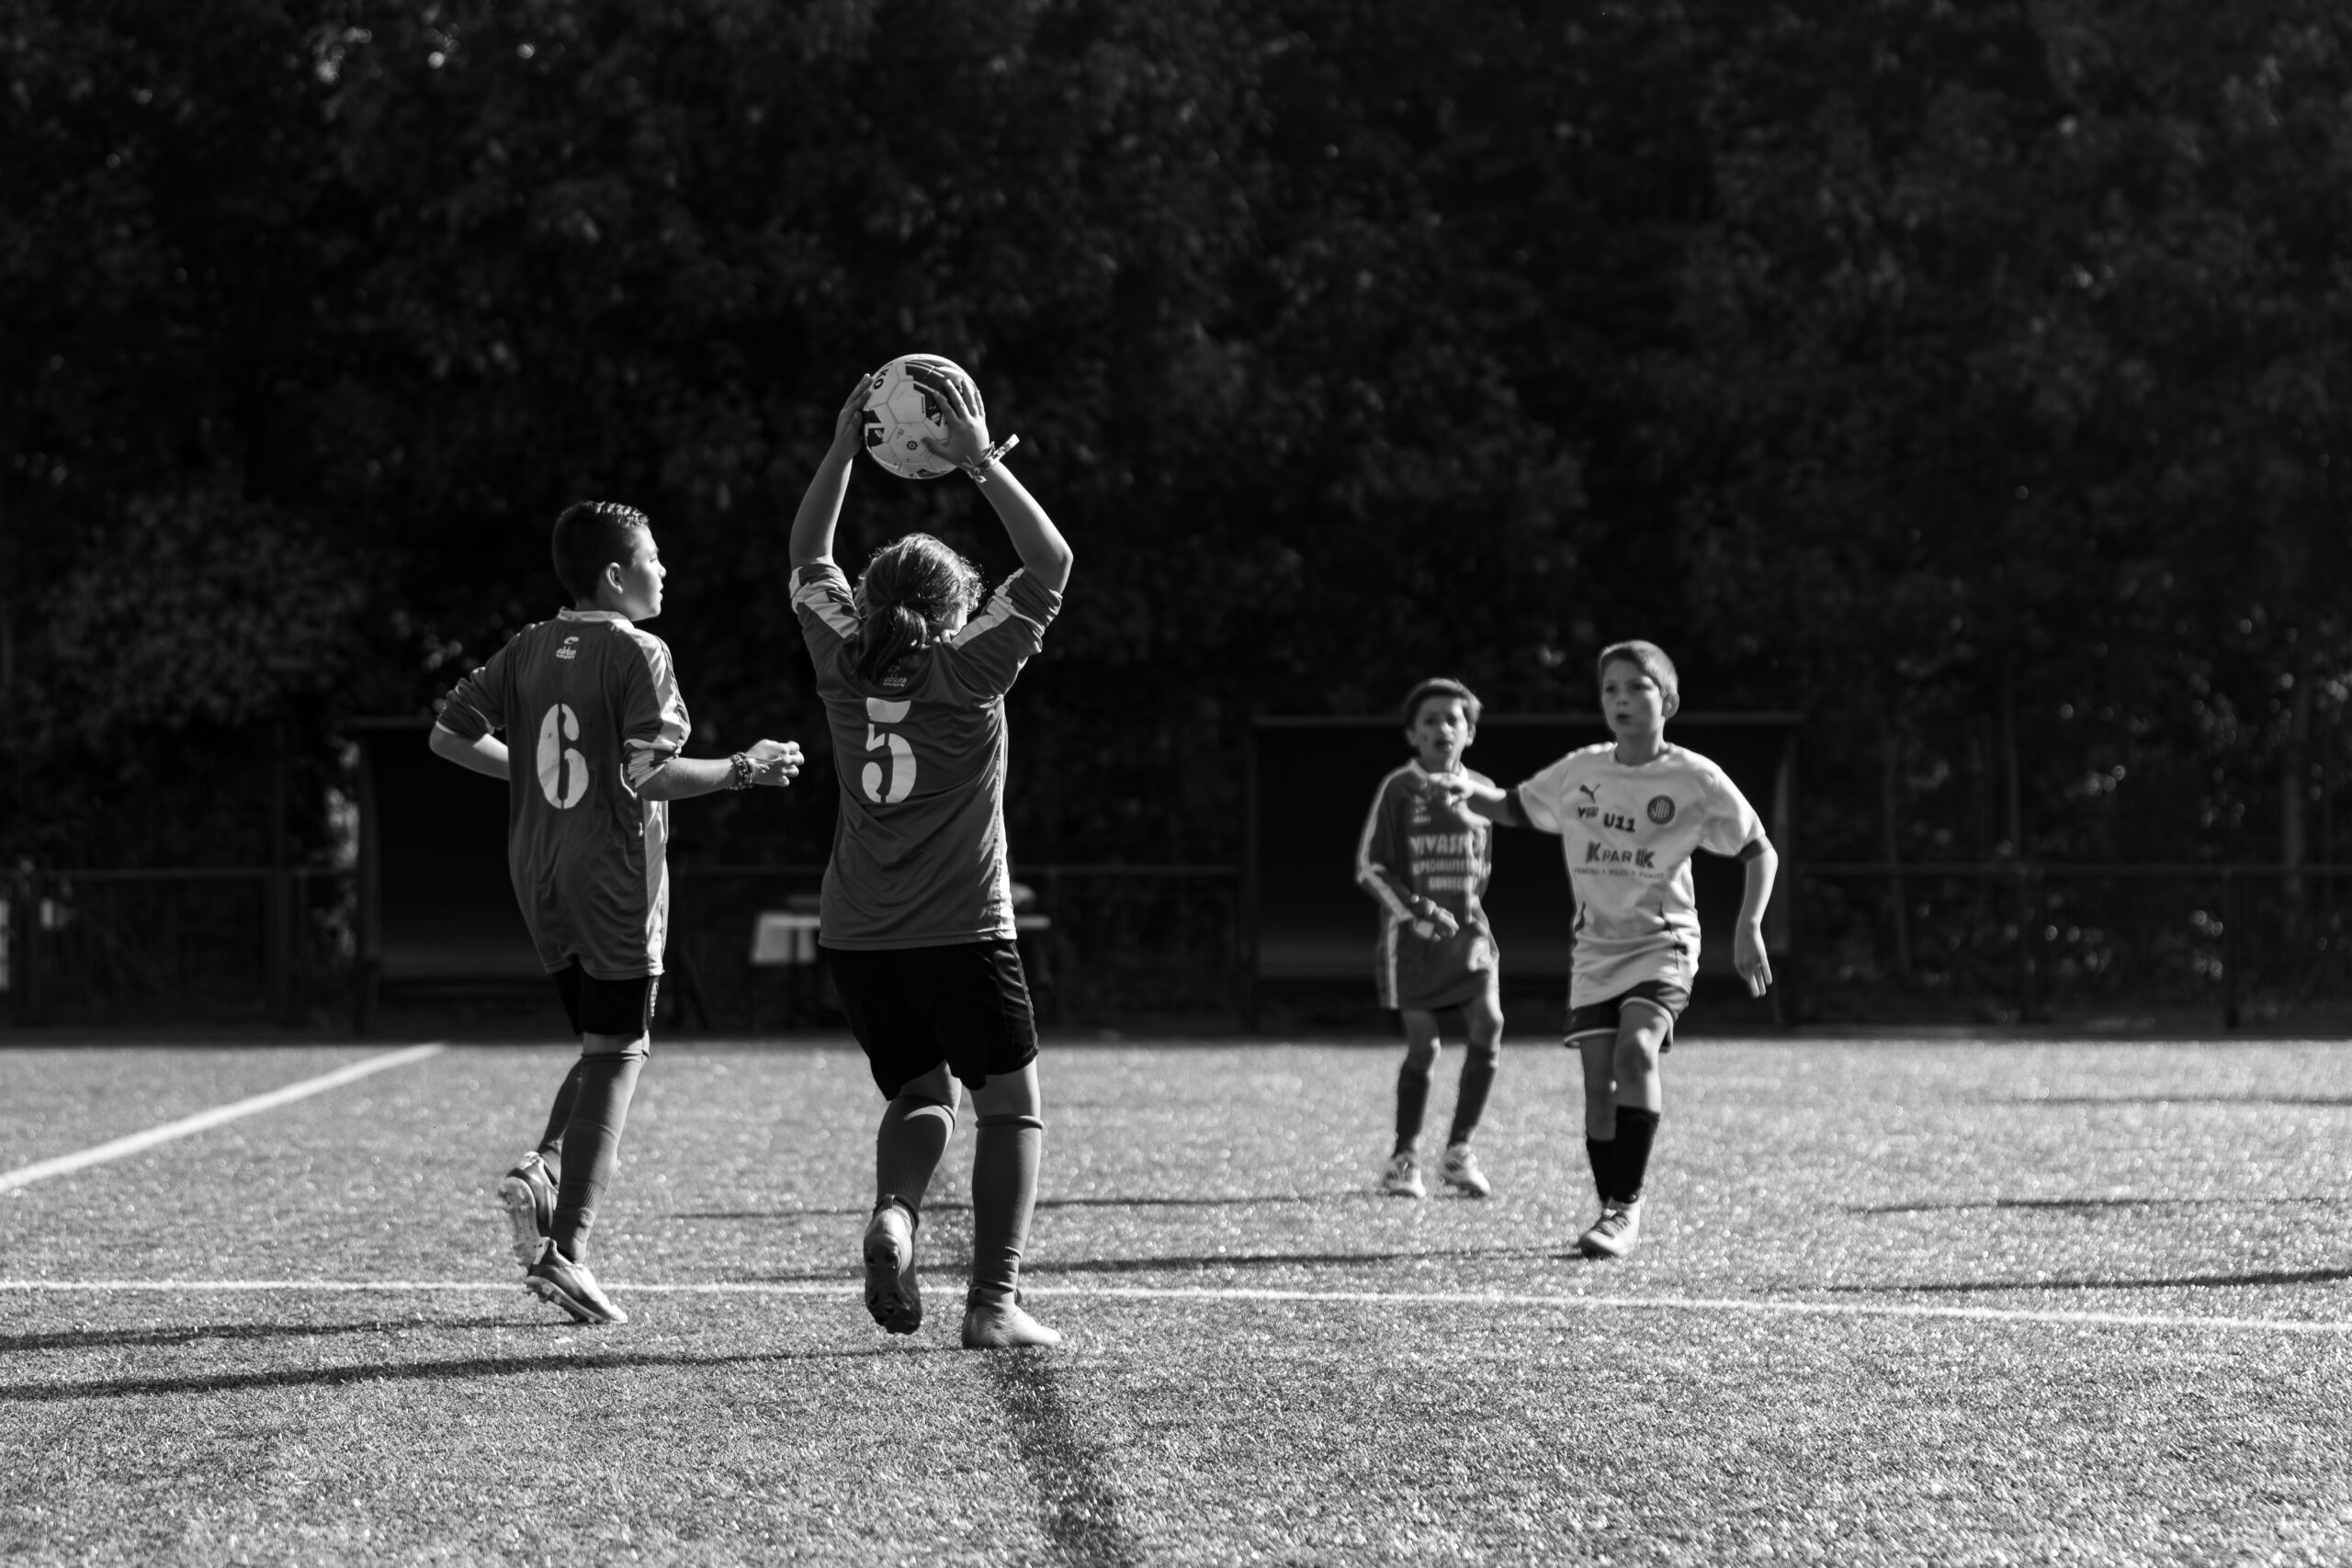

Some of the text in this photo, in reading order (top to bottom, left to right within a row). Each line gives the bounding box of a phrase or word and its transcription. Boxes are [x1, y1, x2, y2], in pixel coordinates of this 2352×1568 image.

[537, 703, 590, 809] 6
[862, 696, 917, 804] 5
[1603, 812, 1636, 833] U11
